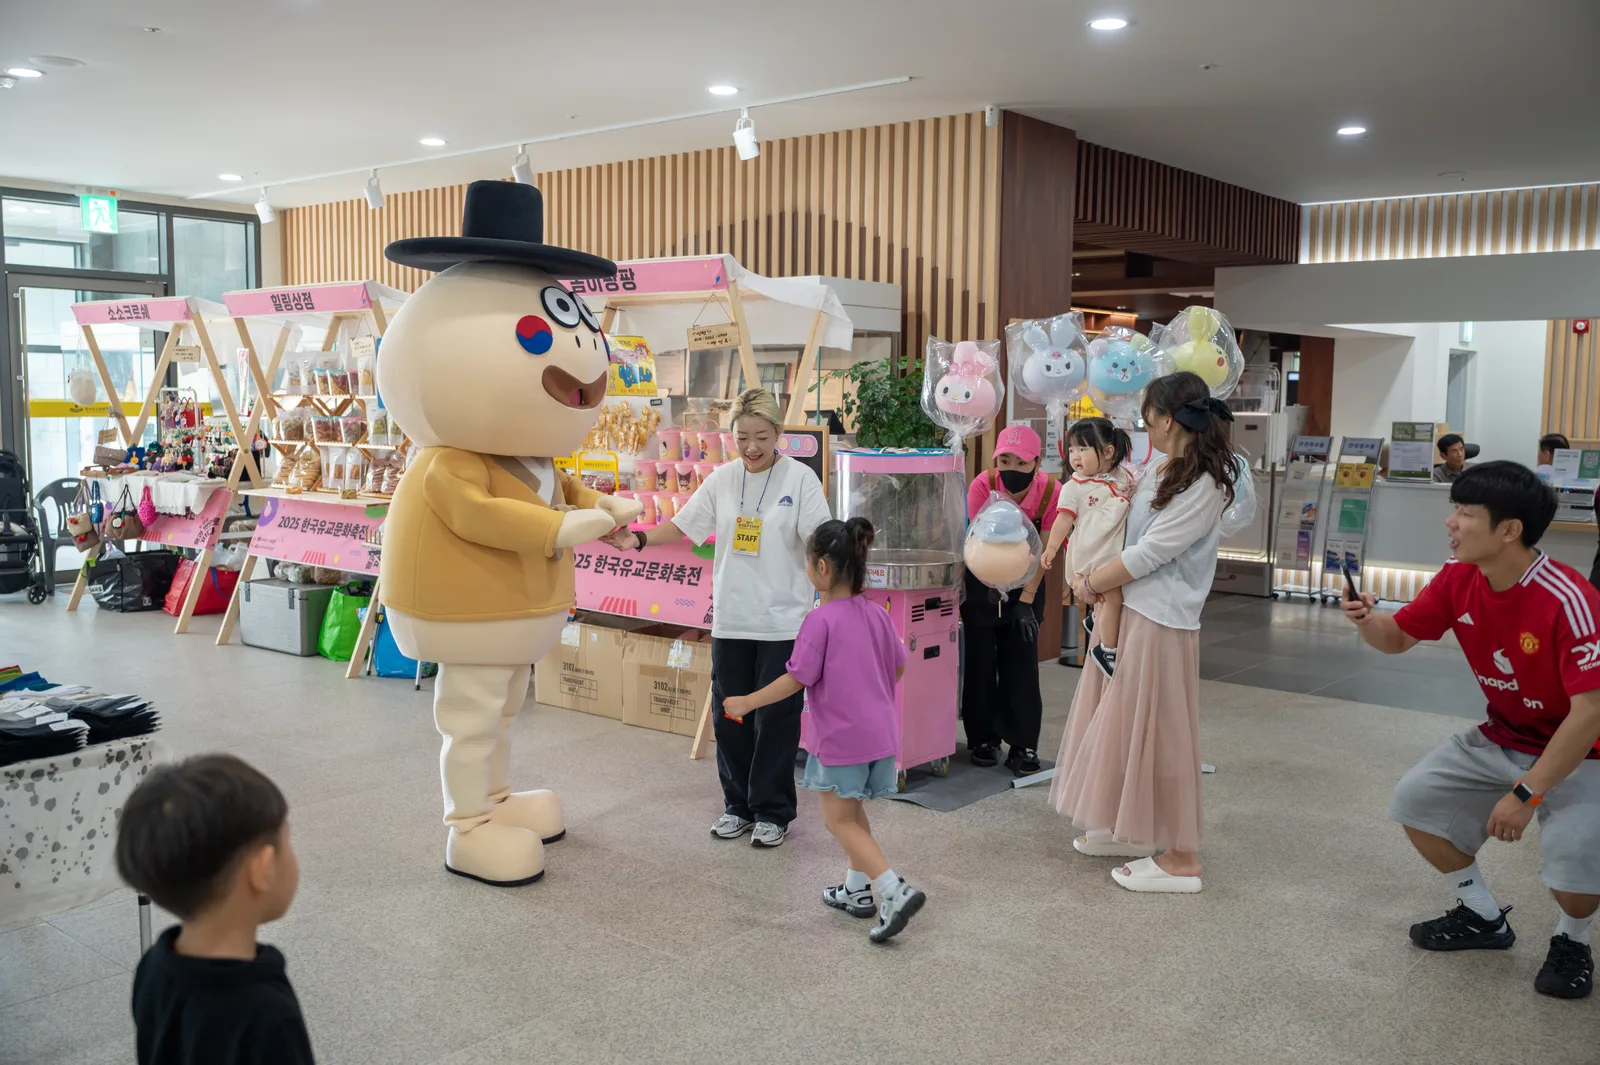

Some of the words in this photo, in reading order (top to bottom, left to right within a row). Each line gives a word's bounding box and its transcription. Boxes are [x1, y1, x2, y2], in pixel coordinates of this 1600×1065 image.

[270, 291, 315, 312] 힐링상점
[107, 303, 151, 320] 소소크로쉐
[278, 515, 301, 529] 2025
[300, 517, 369, 541] 한국유교문화축전
[736, 533, 758, 542] STAFF
[573, 552, 593, 570] 25
[593, 554, 702, 586] 한국유교문화축전
[563, 661, 575, 672] 3102
[653, 680, 668, 692] 3102
